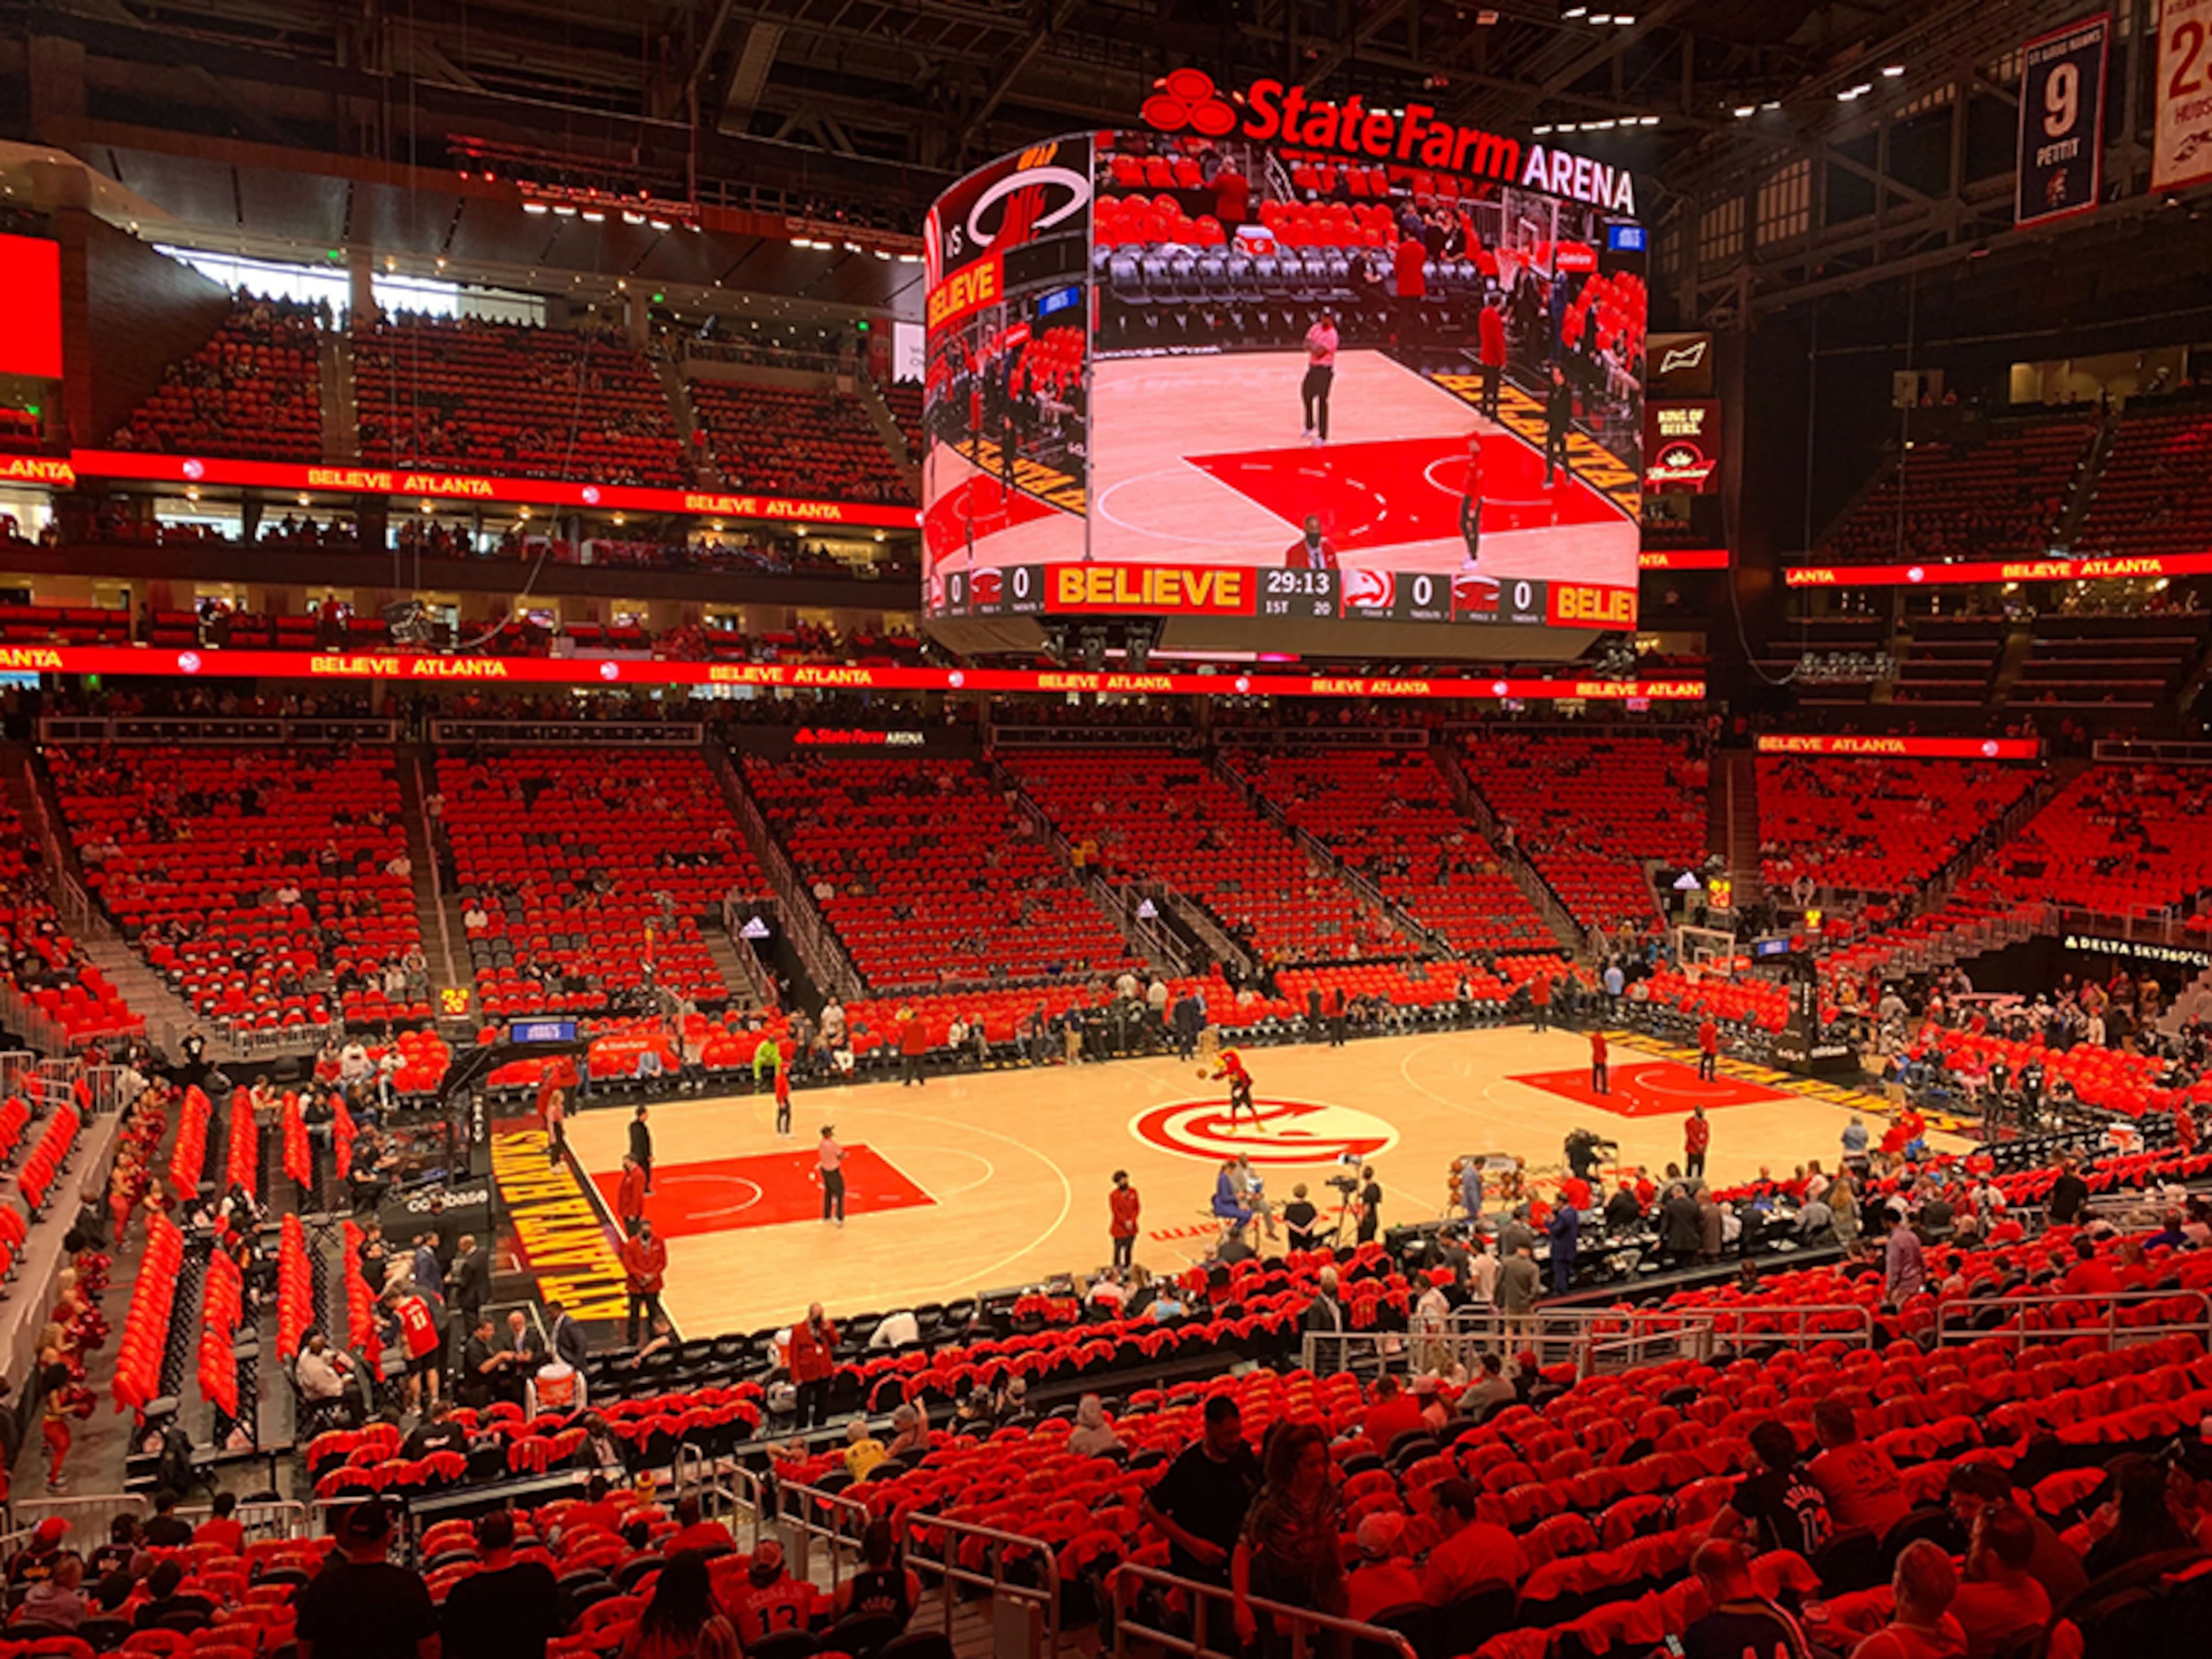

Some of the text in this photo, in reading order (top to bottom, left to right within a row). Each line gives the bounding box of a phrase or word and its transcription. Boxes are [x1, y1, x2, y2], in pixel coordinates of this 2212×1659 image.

[2169, 20, 2212, 99] 2
[2043, 62, 2079, 137] 9
[2036, 138, 2080, 168] PETTIT
[1522, 144, 1636, 215] ARENA
[1657, 408, 1705, 423] KING OF
[308, 469, 493, 495] BELIEVE ATLANTA
[686, 495, 841, 519] BELIEVE ATLANTA
[2002, 558, 2162, 577] BELIEVE ATLANTA
[951, 567, 1029, 604] 0 0
[1059, 568, 1241, 606] BELIEVE
[1267, 571, 1330, 594] 29:13
[1413, 575, 1531, 609] 0 0
[1266, 600, 1289, 614] 1ST
[311, 656, 507, 676] BELIEVE ATLANTA
[709, 665, 872, 684] BELIEVE ATLANTA
[1038, 675, 1172, 690] BELIEVE ATLANTA
[1312, 680, 1430, 694] BELIEVE ATLANTA
[1575, 683, 1637, 696] BELIEVE
[885, 730, 926, 745] ARENA
[1759, 737, 1905, 752] BELIEVE ATLANTA
[2080, 935, 2131, 956] DELTA
[407, 1188, 488, 1213] cobase
[490, 1130, 649, 1320] ATLANTA HAWKS
